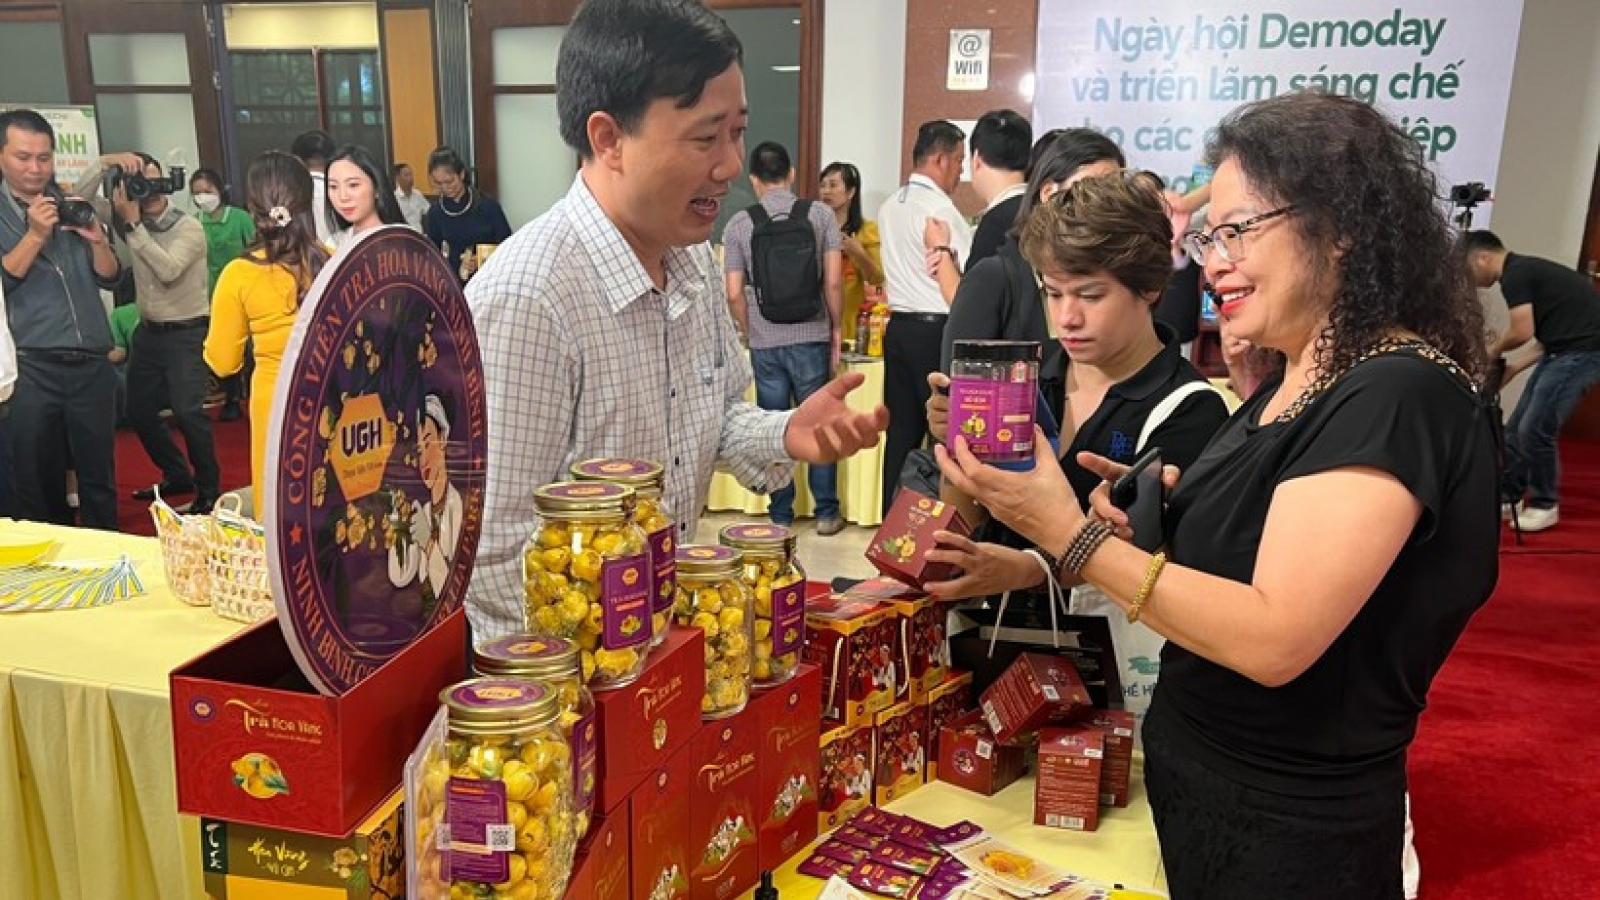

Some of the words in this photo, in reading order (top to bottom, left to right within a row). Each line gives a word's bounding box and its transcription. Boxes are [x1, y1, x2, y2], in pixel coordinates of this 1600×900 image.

[1095, 16, 1185, 62] Ngày
[1193, 14, 1249, 58] hội
[1258, 8, 1446, 56] Demoday
[955, 60, 982, 75] Wifi
[1071, 67, 1110, 102] và
[1120, 62, 1199, 102] triển
[1209, 66, 1278, 101] lãm
[1289, 64, 1379, 105] sáng
[1389, 59, 1466, 100] chế
[57, 133, 87, 155] NH
[1134, 117, 1193, 151] các
[1400, 116, 1457, 162] iệp
[286, 399, 314, 504] CÔNG
[305, 303, 343, 385] VIÊN
[340, 254, 375, 312] TRÀ
[376, 250, 409, 280] HOA
[342, 417, 382, 457] UGH
[292, 553, 325, 640] NINH
